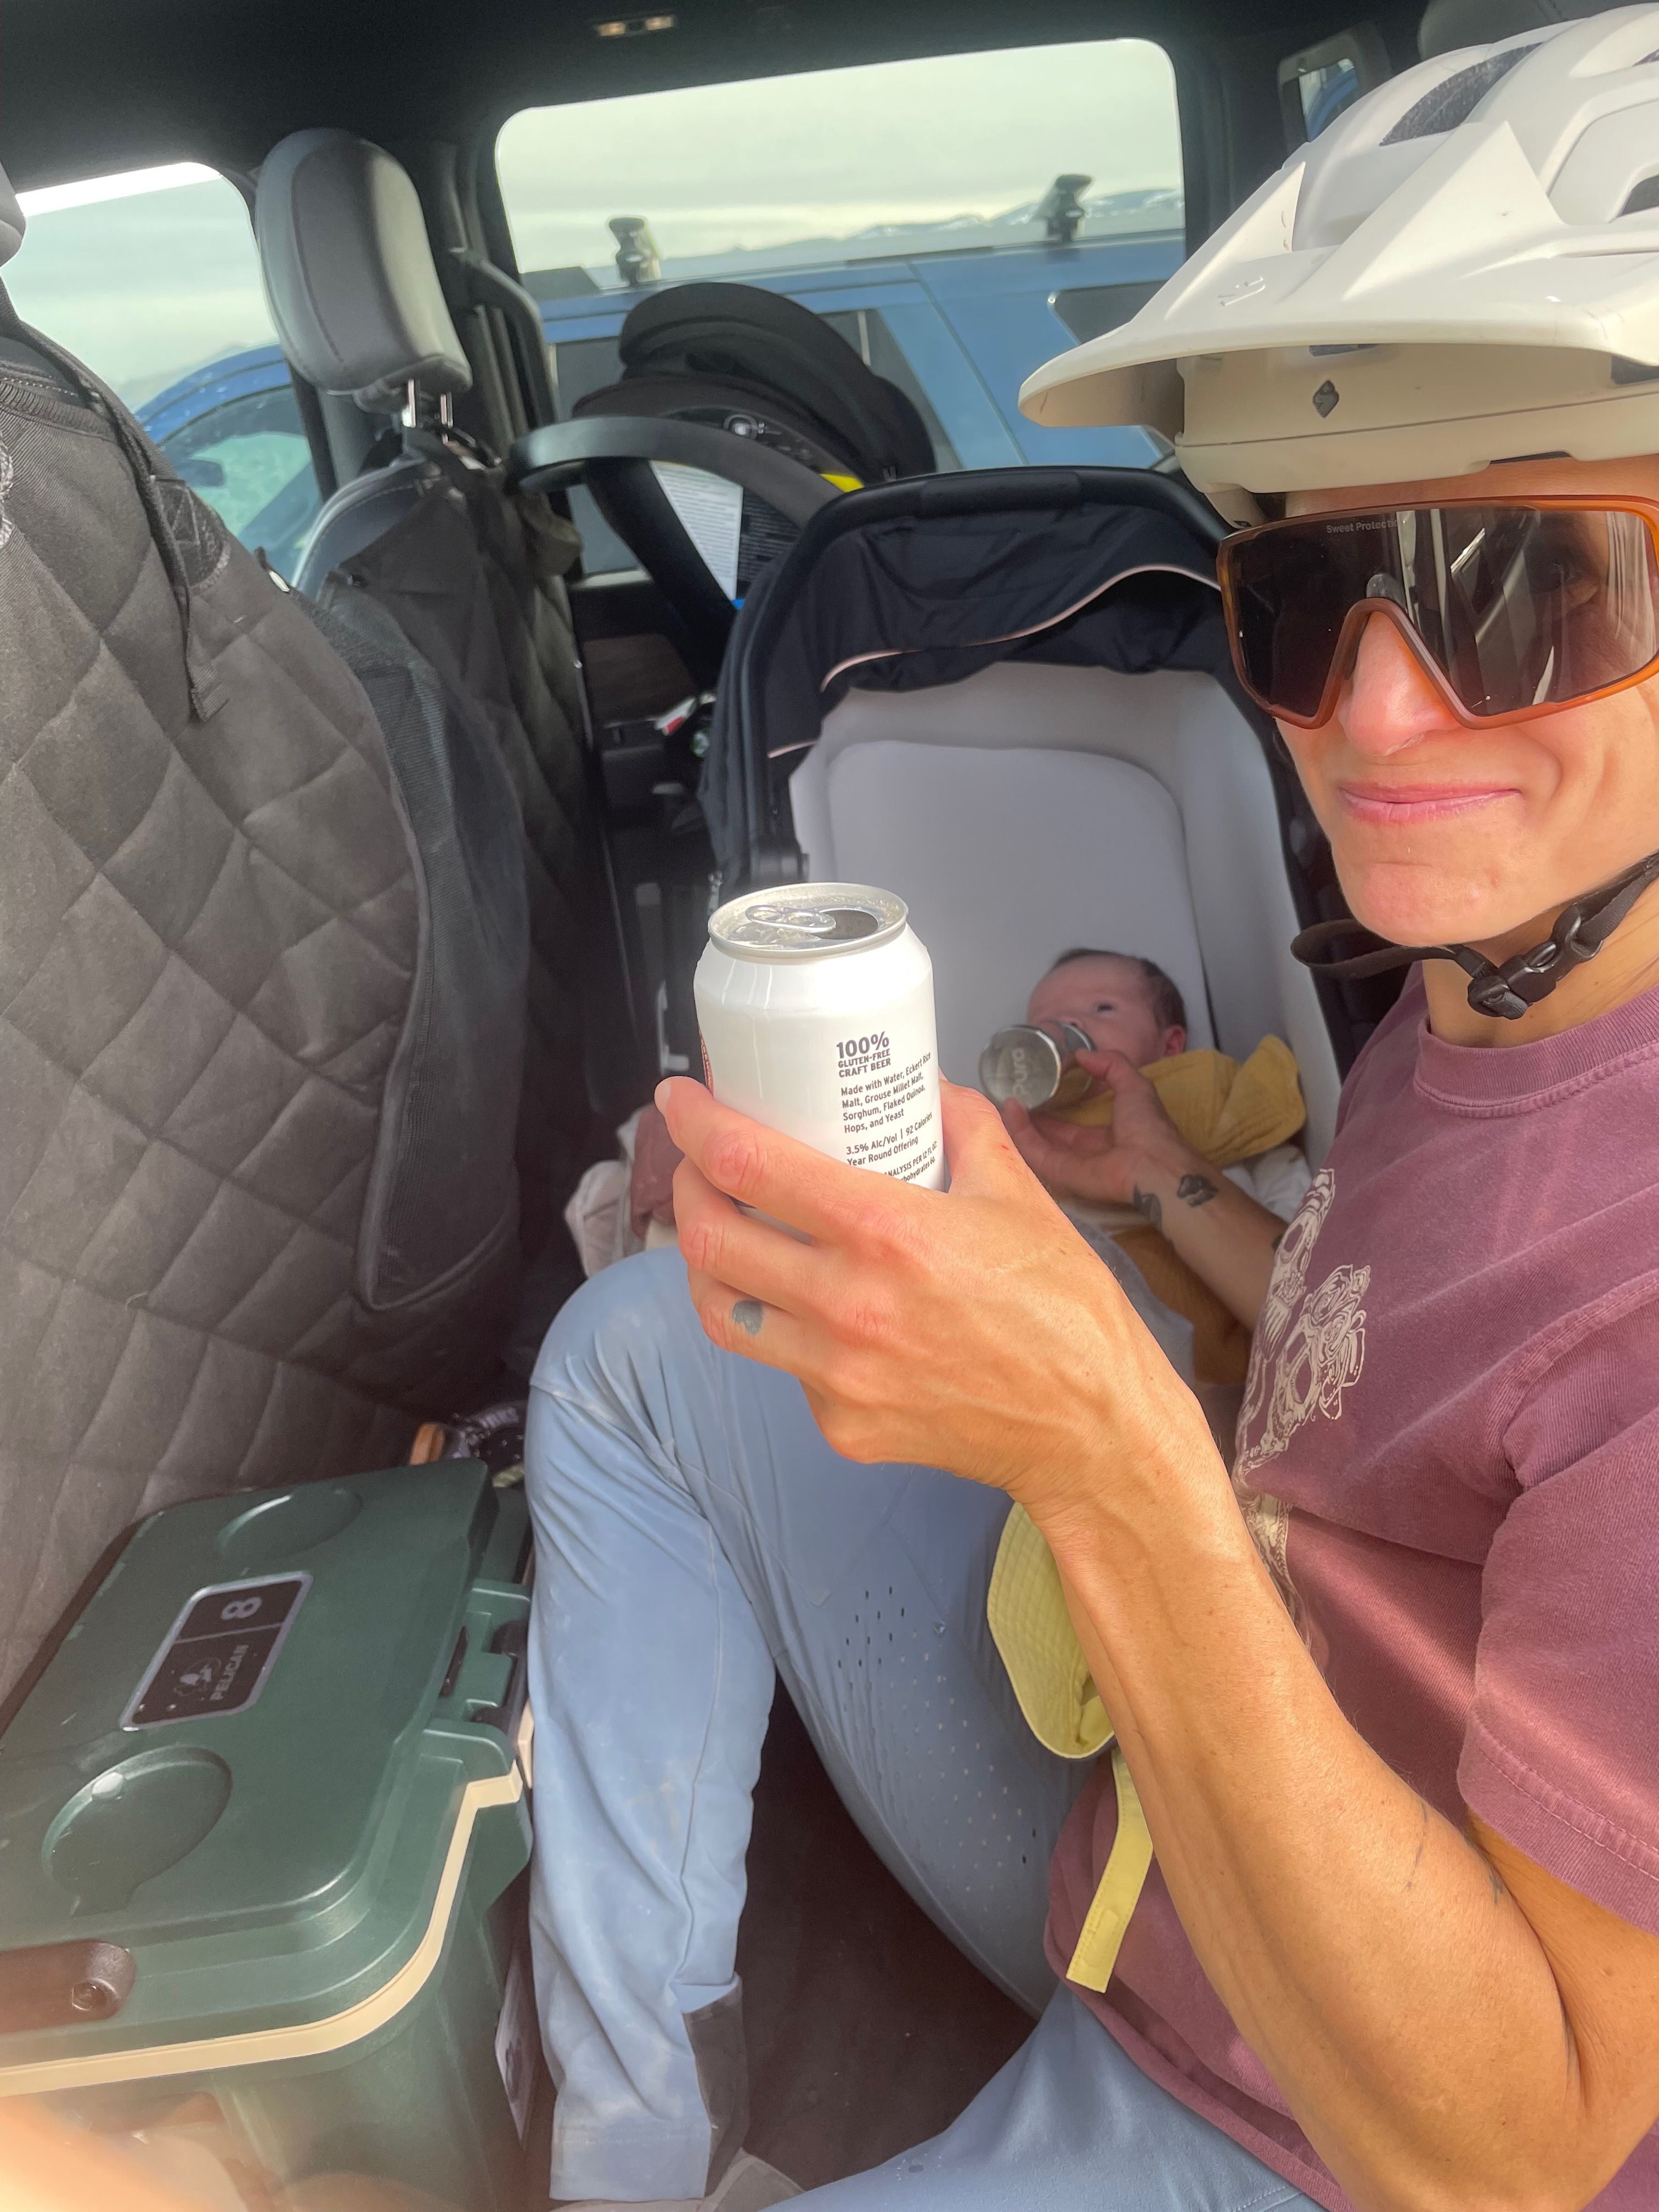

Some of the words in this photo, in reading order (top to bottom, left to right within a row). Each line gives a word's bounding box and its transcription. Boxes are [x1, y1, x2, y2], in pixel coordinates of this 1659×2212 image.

[1327, 523, 1354, 534] Sweat
[1356, 519, 1398, 532] Protectio
[836, 1030, 890, 1059] 100%
[838, 1048, 890, 1068] GLUTEN-FREE
[838, 1064, 868, 1078] CRAFT
[870, 1057, 891, 1071] BEER
[840, 1084, 864, 1097] Made
[865, 1079, 882, 1091] with
[883, 1071, 905, 1086] Water,
[906, 1058, 923, 1076] Eckert
[923, 1052, 931, 1065] Rice
[842, 1097, 863, 1109] Malt,
[865, 1090, 891, 1104] Grouse
[893, 1079, 910, 1095] Millet
[911, 1071, 924, 1086] Malt,
[843, 1107, 882, 1121] Sorghum,
[883, 1094, 906, 1111] Flaked
[906, 1084, 926, 1101] Quinoa,
[844, 1123, 868, 1133] Hops,
[869, 1115, 884, 1128] and
[884, 1108, 905, 1123] Yeast
[846, 1142, 869, 1155] 3.5%
[871, 1132, 898, 1150] Alc/Vol
[906, 1125, 914, 1137] 92
[915, 1111, 933, 1131] Calories
[847, 1156, 866, 1166] Year
[868, 1147, 892, 1163] Round
[893, 1136, 918, 1154] Offering
[913, 1154, 922, 1167] PER
[923, 1150, 927, 1160] 12
[220, 1596, 263, 1621] 8
